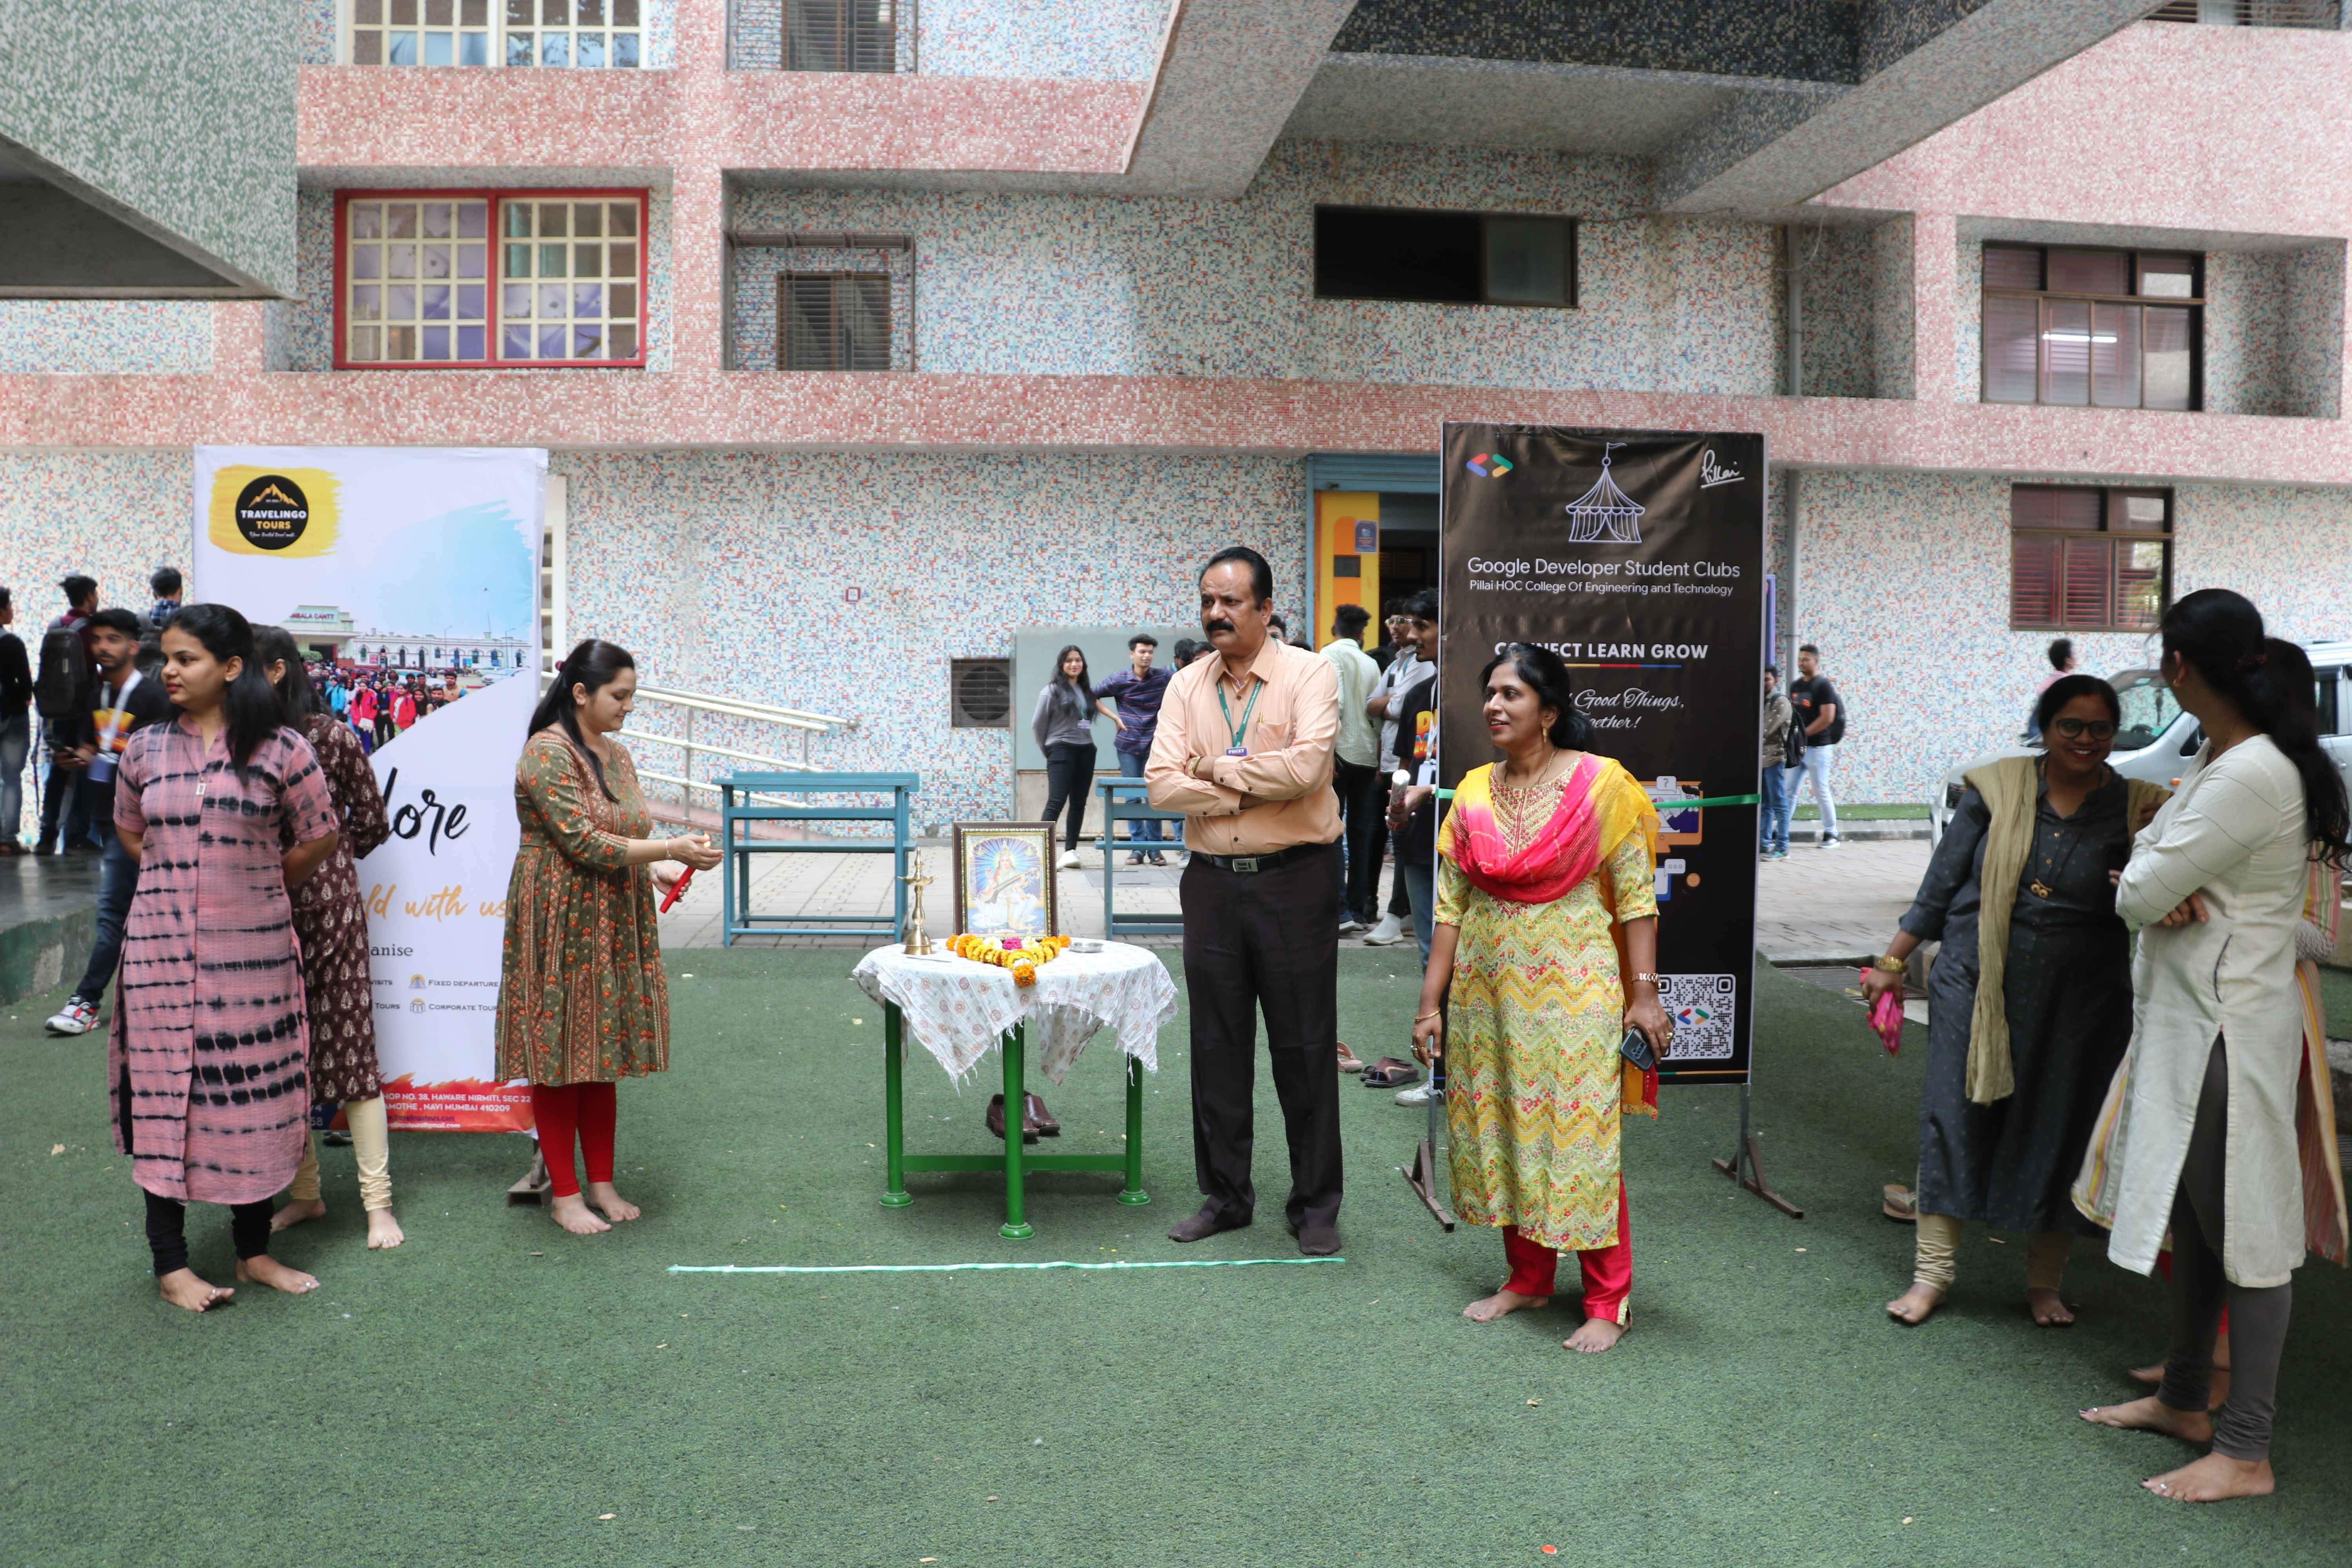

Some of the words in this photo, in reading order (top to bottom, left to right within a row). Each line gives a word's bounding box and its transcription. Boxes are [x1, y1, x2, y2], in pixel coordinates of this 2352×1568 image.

[241, 510, 307, 519] TRAVELINGO
[256, 521, 291, 529] TOURS
[1468, 557, 1530, 577] Google
[1535, 559, 1622, 578] Developer
[1625, 560, 1690, 575] Student
[1694, 561, 1740, 577] Clubs
[1470, 580, 1494, 590] Pillai
[1496, 580, 1523, 590] HOC
[1526, 581, 1566, 594] College
[1569, 582, 1583, 592] Of
[1586, 583, 1648, 595] Engineering
[1651, 584, 1671, 593] and
[1673, 583, 1733, 596] Technology
[1588, 644, 1645, 658] LEARN
[1651, 644, 1708, 659] GROW
[1574, 689, 1621, 710] Good
[1623, 688, 1684, 711] Things,
[405, 884, 468, 923] with
[370, 944, 413, 956] anise
[480, 1104, 510, 1112] 410209
